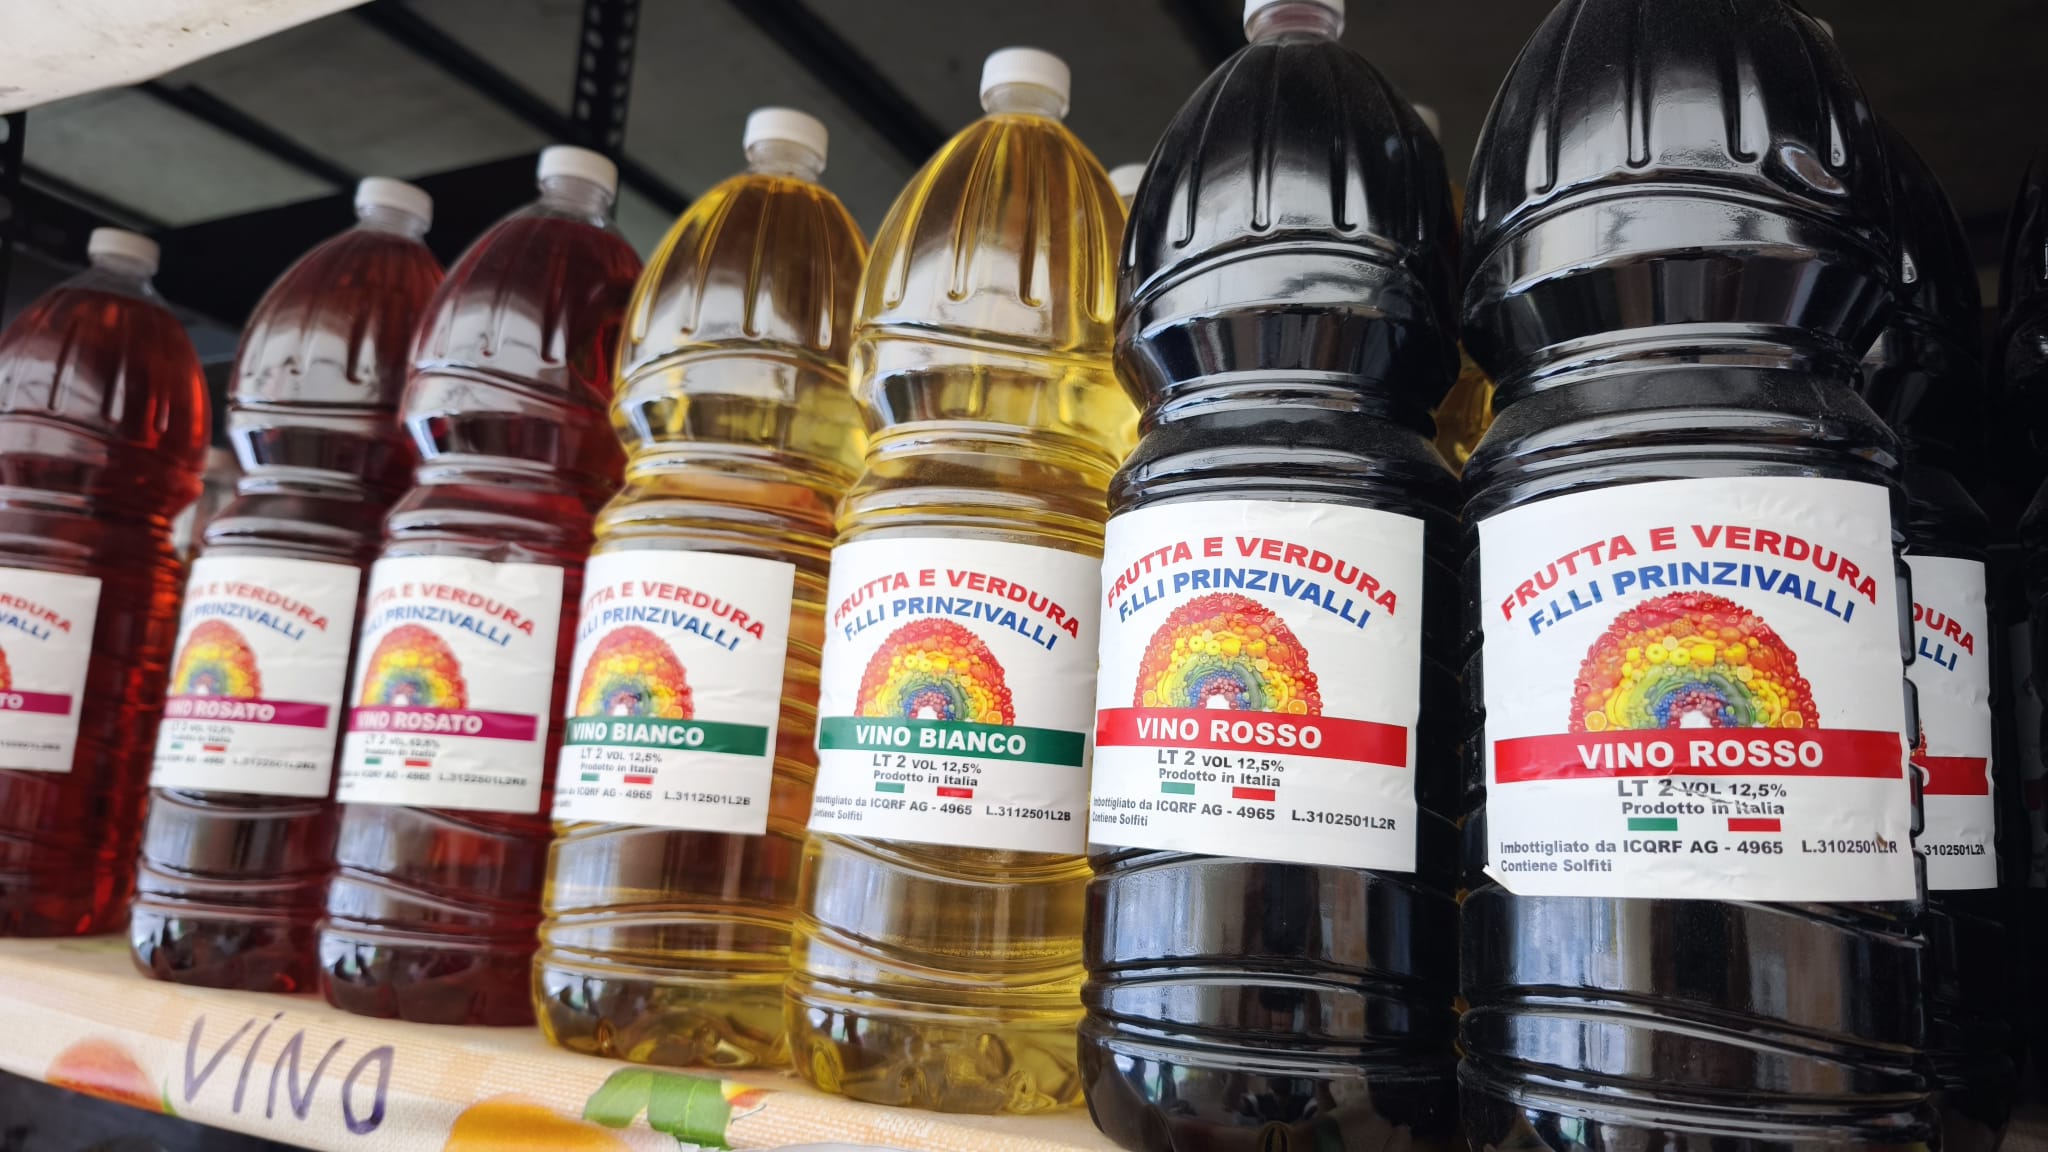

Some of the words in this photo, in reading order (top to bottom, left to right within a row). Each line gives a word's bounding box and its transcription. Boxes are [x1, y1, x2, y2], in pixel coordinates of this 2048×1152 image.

[1107, 541, 1193, 608] FRUTTA
[1203, 536, 1223, 557] E
[1235, 536, 1398, 616] VERDURA
[1501, 535, 1636, 621] FRUTTA
[1649, 526, 1677, 552] E
[1691, 525, 1877, 605] VERDURA
[421, 583, 536, 637] VERDURA
[621, 581, 635, 597] E
[641, 581, 766, 640] VERDURA
[834, 572, 910, 627] FRUTTA
[919, 569, 936, 586] E
[946, 568, 1080, 639] VERDURA
[1120, 581, 1165, 624] F.LLI
[1173, 567, 1372, 629] PRINZIVALLI
[1529, 581, 1604, 636] F.LLI
[1612, 561, 1855, 624] PRINZIVALLI
[385, 605, 512, 648] PRINZIVALLI
[602, 606, 740, 652] PRINZIVALLI
[844, 604, 885, 642] F.LLI
[893, 596, 1058, 651] PRINZIVALLI
[1913, 603, 1974, 656] DURA
[394, 712, 483, 736] ROSATO
[572, 722, 606, 741] VINO
[612, 723, 705, 746] BIANCO
[1136, 718, 1200, 741] VINO
[1210, 719, 1323, 749] ROSSO
[855, 724, 911, 747] VINO
[919, 727, 1026, 756] BIANCO
[872, 754, 892, 768] LT
[896, 755, 906, 768] 2
[912, 759, 938, 771] VOL
[942, 761, 982, 775] 12,5%
[1157, 749, 1179, 766] LT
[1184, 750, 1195, 766] 2
[1202, 755, 1232, 769] VOL
[1237, 758, 1285, 773] 12,5%
[1577, 741, 1674, 769] VINO
[1689, 740, 1823, 768] ROSSO
[873, 770, 924, 782] Prodotto
[928, 772, 939, 784] in
[944, 774, 978, 787] Italia
[1159, 768, 1216, 783] Prodotto
[1221, 770, 1235, 784] in
[1240, 773, 1281, 787] Italia
[1618, 780, 1648, 797] LT
[1658, 780, 1674, 796] 2
[1682, 782, 1721, 797] VOL
[1728, 783, 1787, 798] 12,5%
[625, 790, 653, 800] 4965
[1622, 801, 1705, 815] Prodotto
[1711, 801, 1728, 815] in
[1735, 800, 1785, 815] Italia
[837, 809, 863, 821] Solfiti
[855, 798, 867, 808] da
[870, 798, 906, 811] ICQRF
[910, 801, 928, 813] AG
[940, 803, 973, 816] 4965
[986, 806, 1072, 822] L.3112501L2B
[1119, 813, 1148, 827] Solfiti
[1139, 799, 1152, 810] da
[1156, 800, 1197, 815] ICQRF
[1201, 803, 1222, 817] AG
[1236, 806, 1275, 820] 4965
[1291, 810, 1396, 831] L.3102501L2R
[1500, 840, 1590, 856] Imbottigliato
[1595, 840, 1616, 854] da
[1623, 840, 1683, 854] ICQRF
[1690, 840, 1719, 854] AG
[1737, 840, 1784, 855] 4965
[1924, 844, 1986, 857] 3102501L2R
[1501, 859, 1558, 872] Contiene
[1563, 859, 1612, 872] Solfiti
